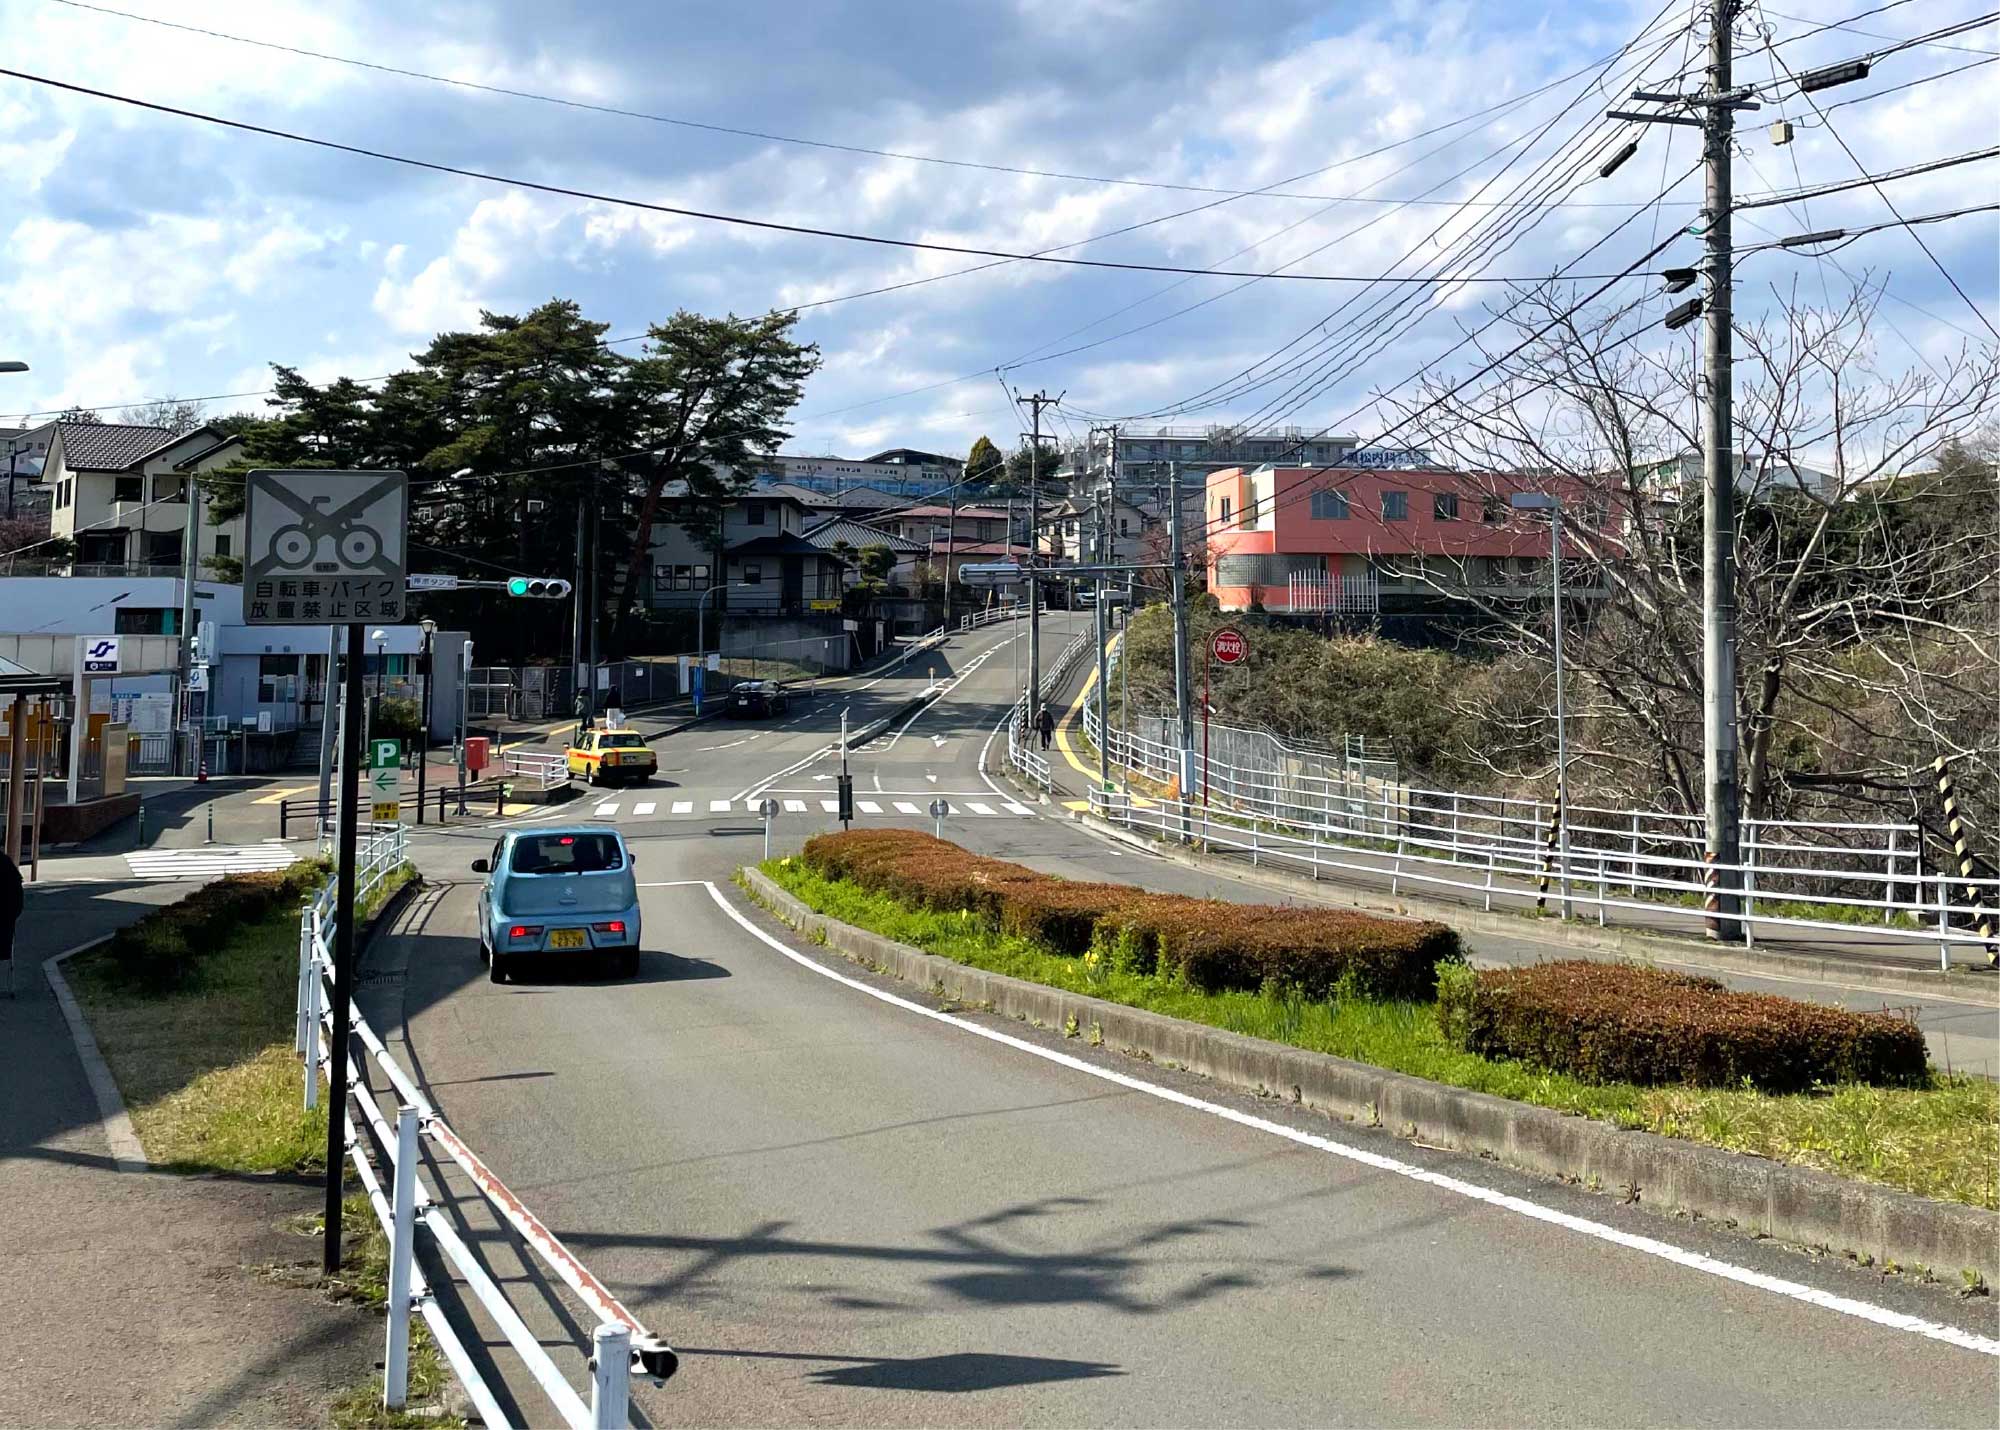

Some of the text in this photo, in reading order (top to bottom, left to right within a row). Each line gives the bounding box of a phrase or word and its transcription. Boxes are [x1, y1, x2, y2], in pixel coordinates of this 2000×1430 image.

[412, 576, 455, 587] 押ボタン式
[250, 601, 400, 618] 放置禁止区域
[1216, 640, 1241, 654] 消火栓
[377, 743, 397, 766] P
